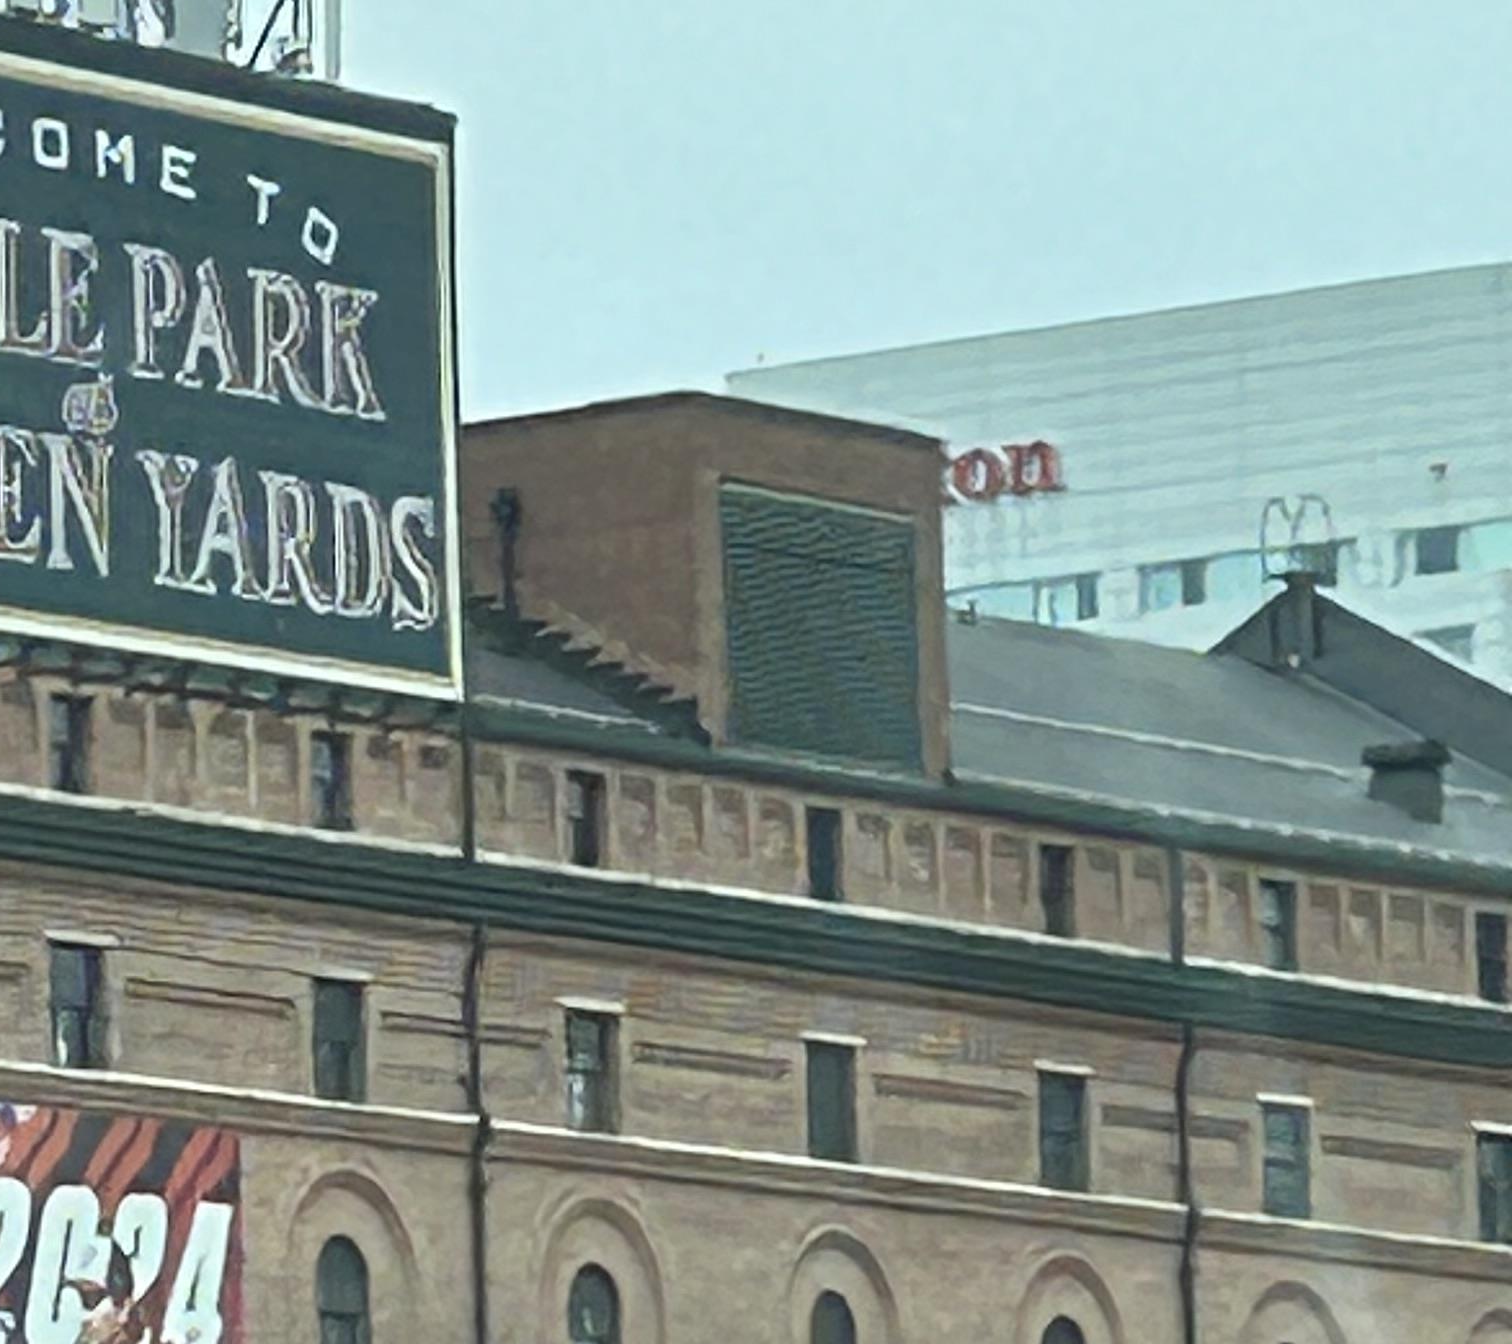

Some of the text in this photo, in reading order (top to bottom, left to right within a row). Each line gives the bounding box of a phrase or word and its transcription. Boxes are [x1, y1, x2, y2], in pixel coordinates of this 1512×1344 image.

[246, 173, 339, 265] TO
[123, 242, 387, 422] PARK
[136, 449, 437, 631] YARDS
